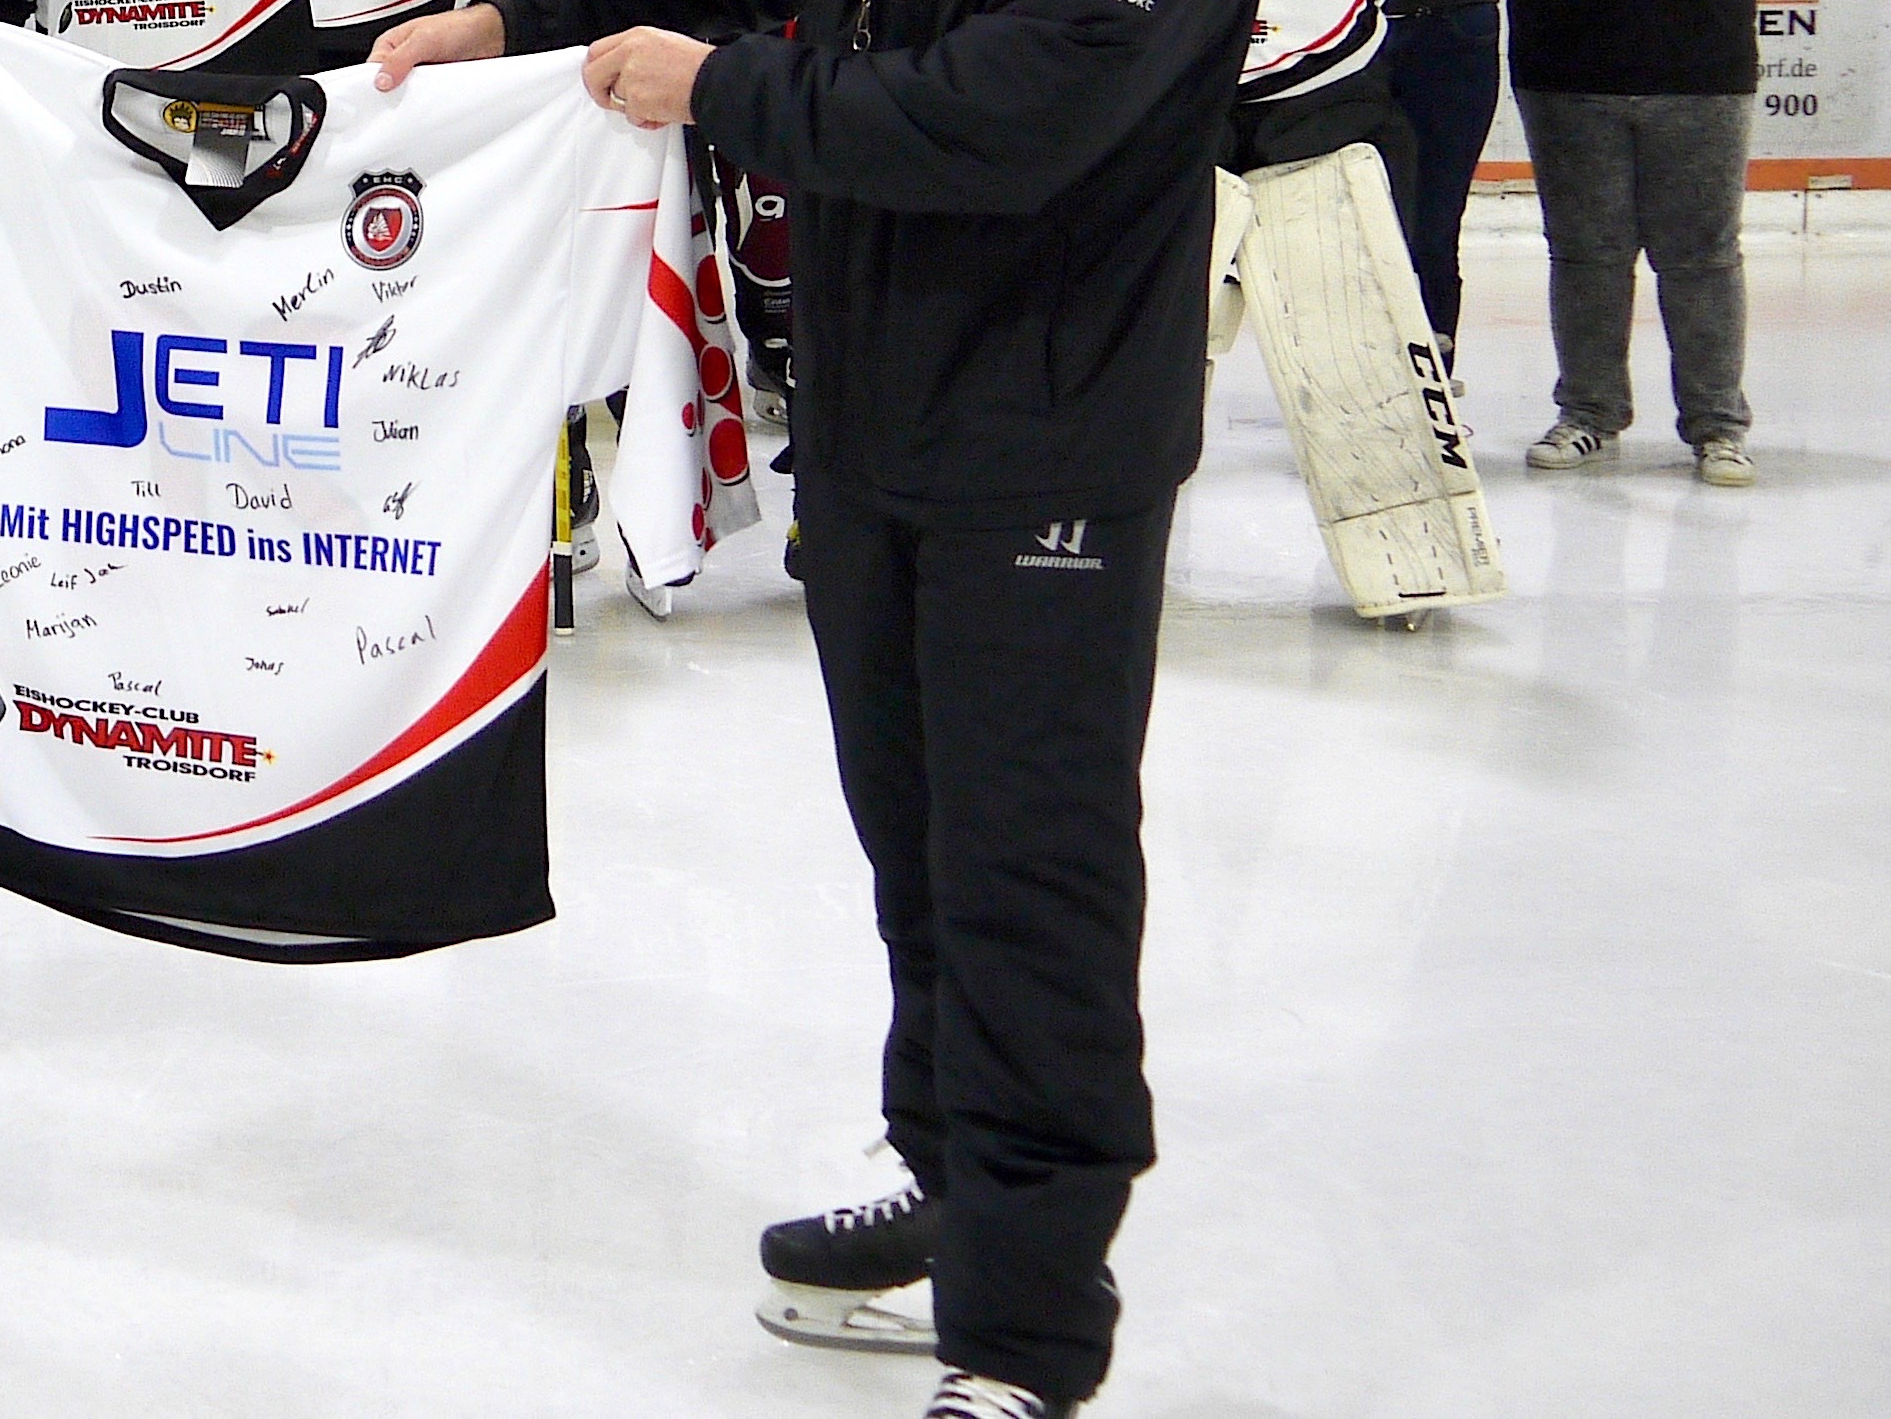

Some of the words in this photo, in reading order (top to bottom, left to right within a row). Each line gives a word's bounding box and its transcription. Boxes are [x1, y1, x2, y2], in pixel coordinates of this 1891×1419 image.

[74, 1, 206, 25] DYNAMITE
[133, 19, 206, 31] TROISDORF
[1765, 94, 1818, 116] 900
[120, 276, 183, 299] Dustin
[271, 268, 336, 322] Merlin
[44, 329, 345, 449] JETI
[1407, 341, 1469, 470] CCM
[158, 421, 343, 472] LINE
[131, 481, 161, 498] Till
[225, 483, 293, 510] David
[61, 508, 236, 558] HIGHSPEED
[248, 528, 292, 564] ins
[302, 531, 443, 577] INTERNET
[357, 615, 437, 666] Pascal
[108, 671, 163, 697] Pascal
[13, 683, 200, 724] EISHOCKEY-CLUB
[13, 699, 257, 768] DYNAMITE
[123, 755, 257, 783] TROISDORF
